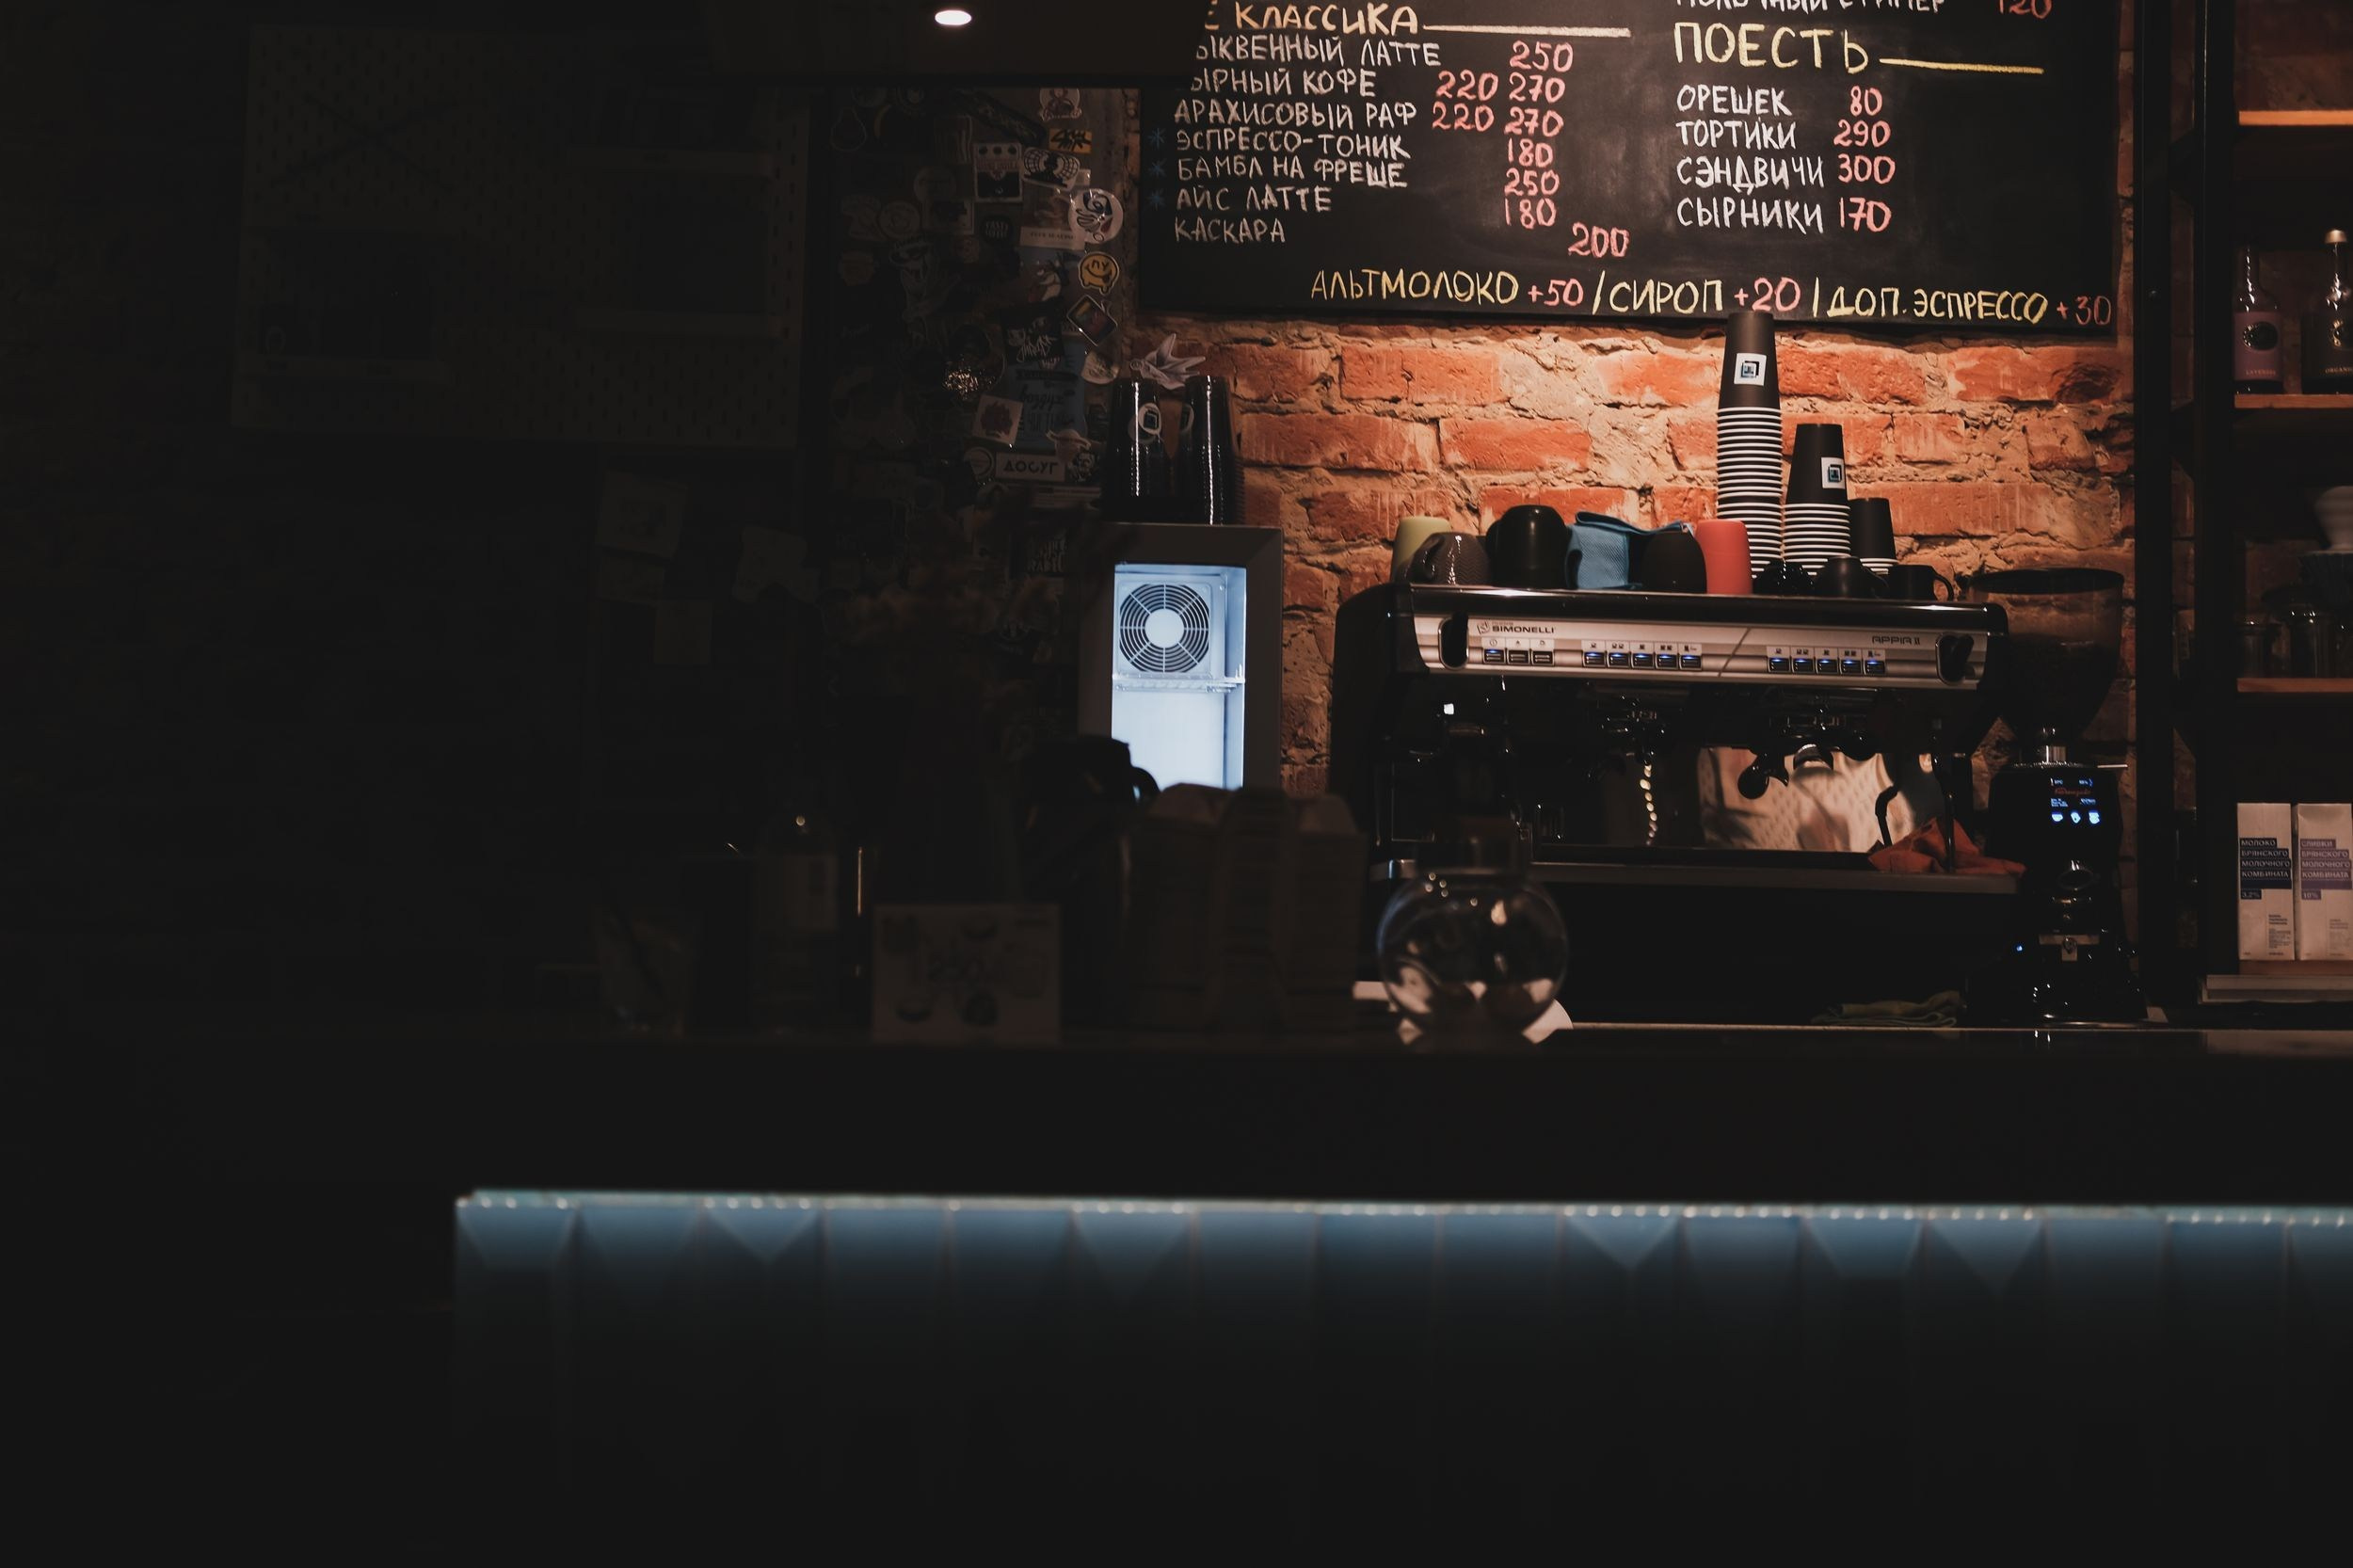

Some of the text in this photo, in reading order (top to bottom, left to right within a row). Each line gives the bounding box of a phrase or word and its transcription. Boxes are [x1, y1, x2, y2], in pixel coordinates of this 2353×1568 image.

[1236, 2, 1418, 35] КЛАССИКА
[1361, 41, 1441, 67] ЛАТТЕ
[1510, 40, 1574, 72] 250
[1674, 22, 1868, 74] ПОЕСТЬ
[1303, 70, 1377, 97] КОФЕ
[1436, 70, 1498, 101] 220
[1509, 72, 1565, 102] 270
[1676, 85, 1883, 118] ОРЕШЕК 80
[1367, 103, 1417, 130] РАФ
[1433, 102, 1495, 132] 220
[1504, 108, 1564, 137] 270
[1675, 120, 1891, 151] ТОРТИКИ 290
[1176, 129, 1554, 168] ЭСПРЕССО-ТОНИК 180
[1177, 157, 1560, 198] БАМБЛ НА ФРЕШЕ 250
[1676, 153, 1897, 194] СЭНДВИЧИ 300
[1176, 184, 1557, 229] АЙС ЛАТТЕ 180
[1676, 197, 1891, 234] СЫРНИКИ 170
[1175, 217, 1286, 244] КАСКАРА
[1568, 223, 1629, 258] 200
[1311, 269, 1519, 304] АЛЬТМОЛОКО
[1913, 289, 2049, 324] ЭСПРЕССО
[1003, 460, 1059, 475] ДОСУГ
[1492, 625, 1554, 633] SIMONELLI
